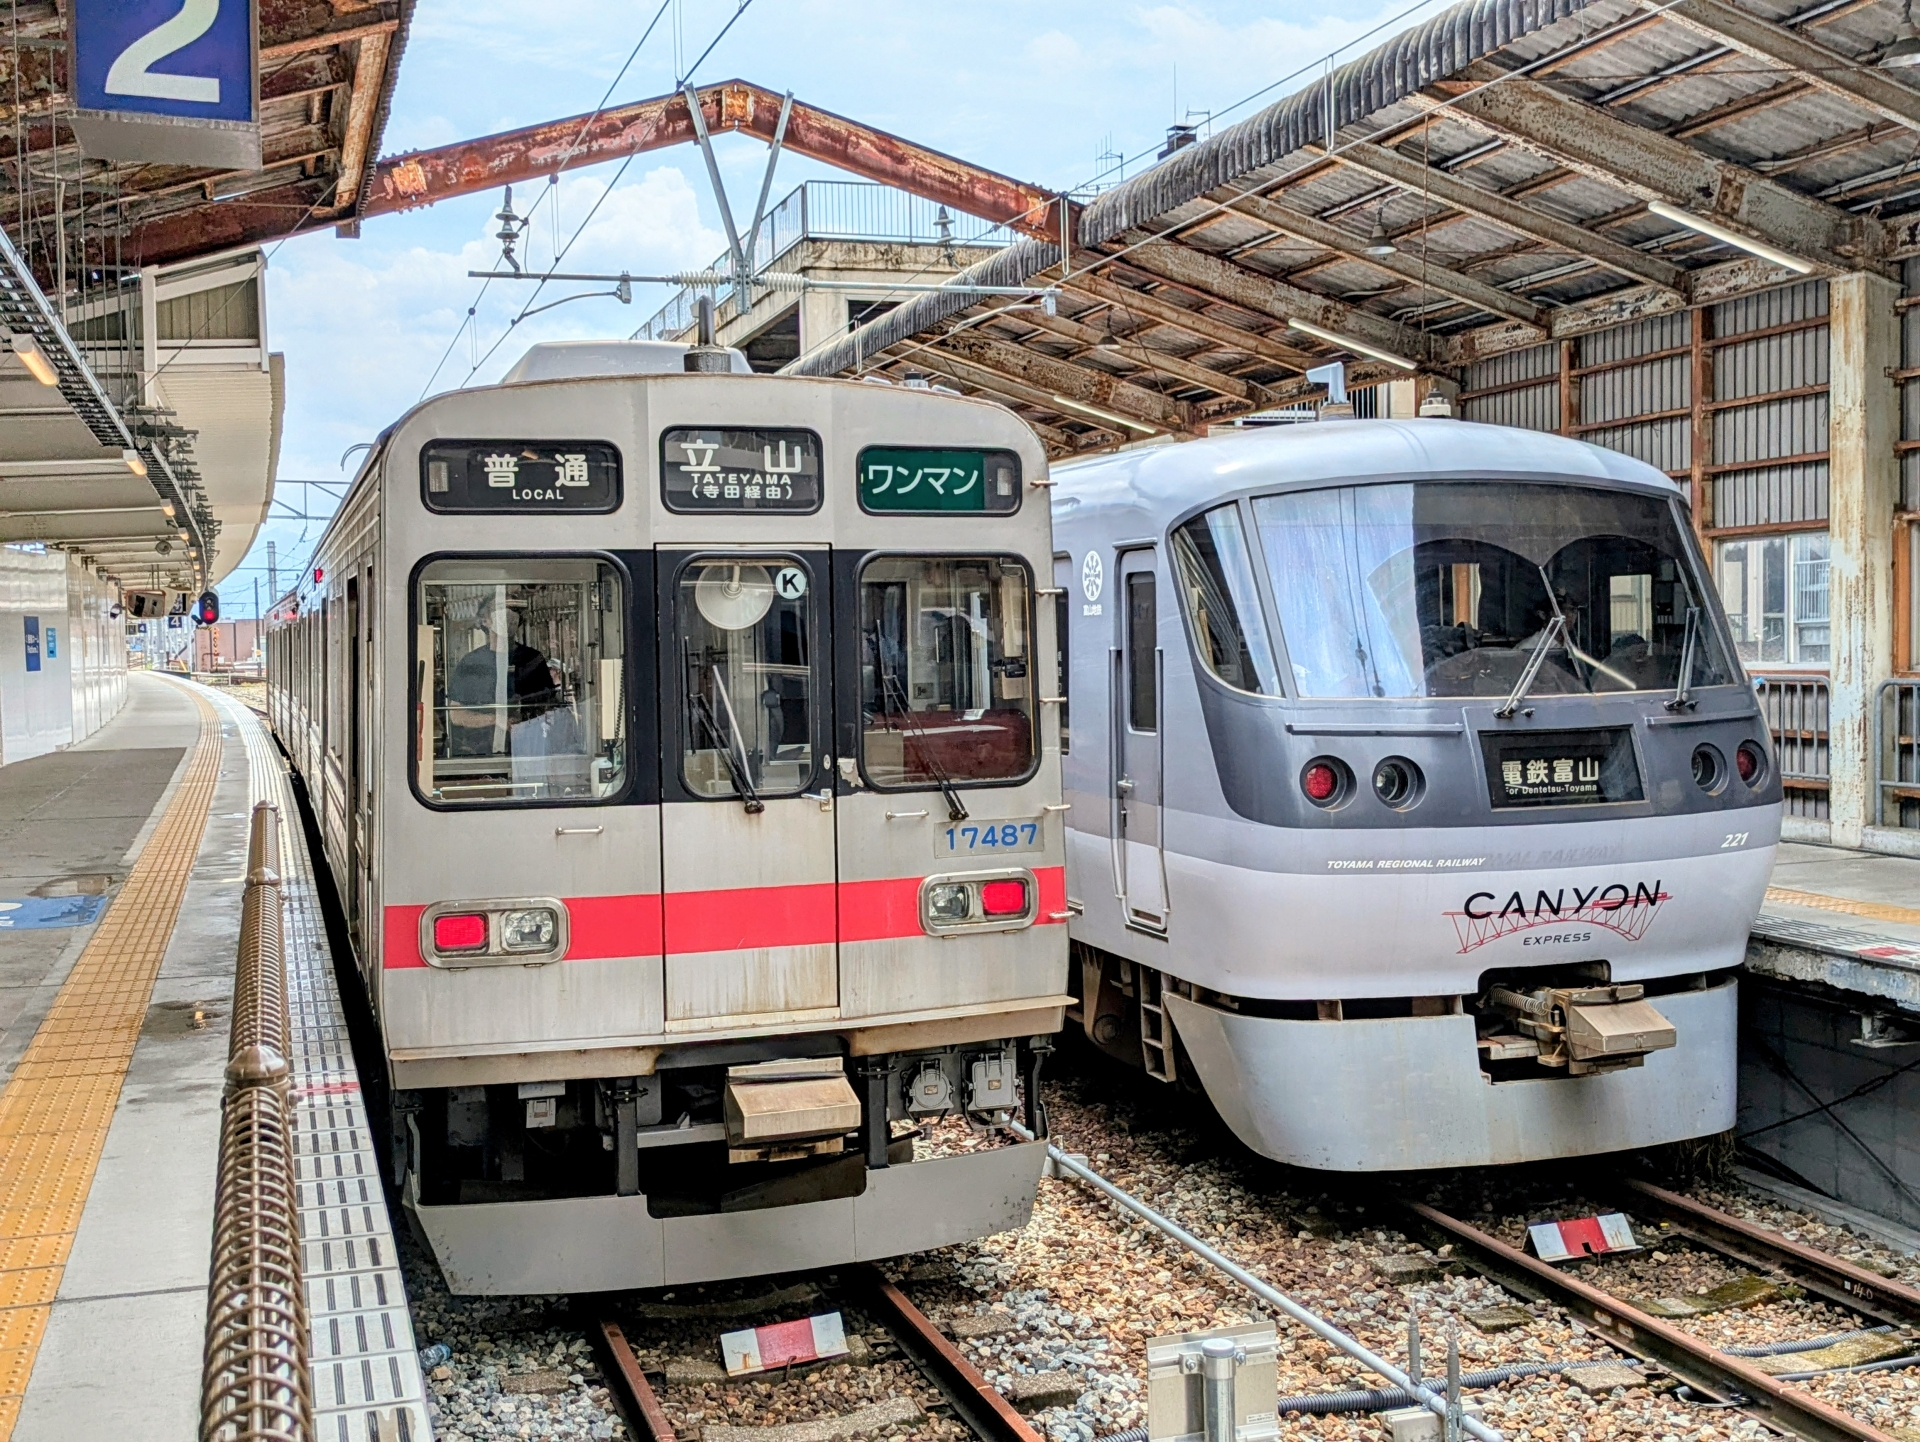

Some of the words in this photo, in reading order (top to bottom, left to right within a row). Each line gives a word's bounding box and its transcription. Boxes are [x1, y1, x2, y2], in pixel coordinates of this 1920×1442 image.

[105, 0, 220, 103] 2
[680, 439, 802, 473] 立山
[484, 454, 590, 487] 普通
[691, 473, 791, 484] TATEYAMA
[868, 465, 979, 495] ワンマン
[512, 489, 564, 500] LOCAL
[782, 573, 800, 593] K
[170, 616, 181, 627] 4
[1502, 757, 1599, 785] 電鉄富山
[1522, 784, 1597, 794] Dentetsu-Toyama
[946, 823, 1037, 850] 17487
[1721, 832, 1749, 848] 221
[1327, 860, 1374, 869] TOYAMA
[1376, 859, 1434, 868] REGIONAL
[1436, 857, 1486, 867] RAILWAY
[1464, 880, 1661, 919] CANYON
[1523, 932, 1592, 946] EXPRESS
